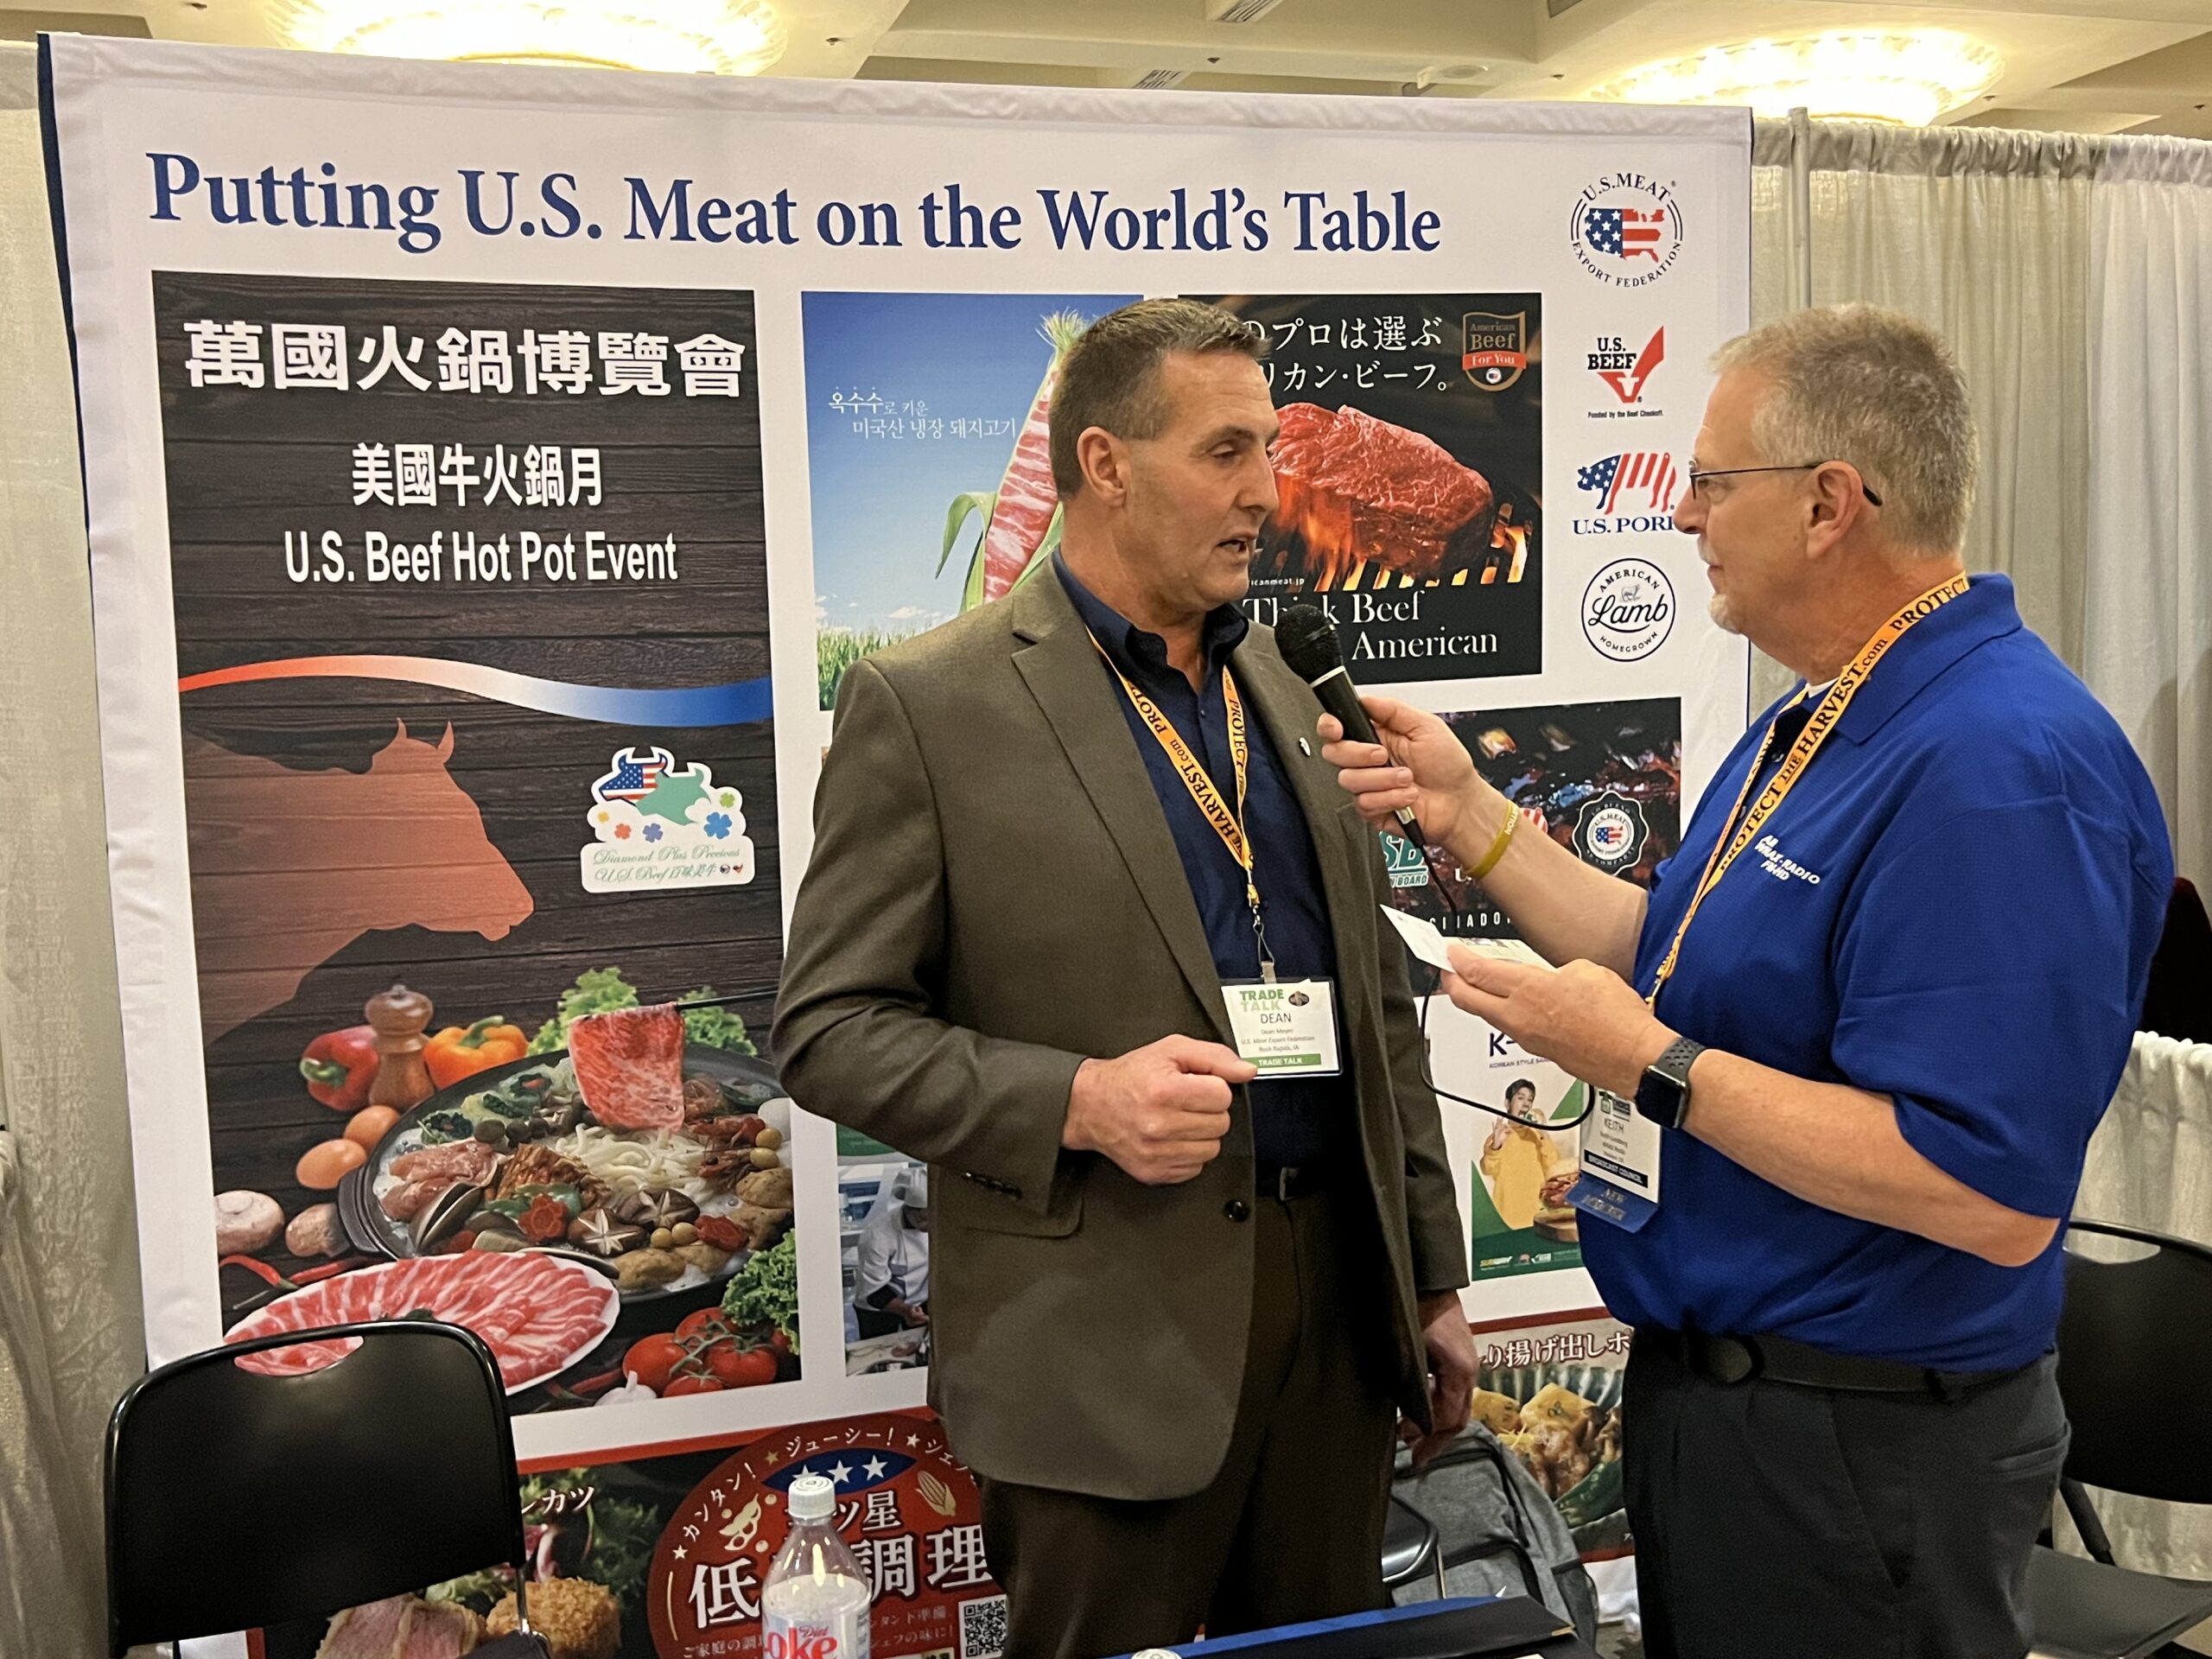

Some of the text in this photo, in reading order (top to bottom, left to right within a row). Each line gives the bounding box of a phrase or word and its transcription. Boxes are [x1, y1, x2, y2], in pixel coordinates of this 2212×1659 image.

[145, 153, 1442, 254] Putting U.S. Meat on the World’s Table
[1572, 241, 1681, 288] EXPORT FEDERATION
[1471, 333, 1516, 352] Beef
[1597, 337, 1627, 353] U.S.
[182, 318, 747, 398] 萬國火鍋博覽會
[1471, 353, 1516, 367] For You
[1587, 353, 1637, 371] BEEF
[853, 417, 1017, 440] 미국산 냉장 돼지고기
[351, 442, 603, 508] 美國牛火鍋月
[1572, 518, 1611, 536] U.S.
[284, 530, 679, 583] U.S. Beef Hot Pot Event
[1249, 576, 1305, 588] icanmeat.jp
[1599, 569, 1660, 593] AMERICAN
[1243, 590, 1426, 627] Thk Beef
[1587, 594, 1669, 632] Lamb
[1351, 626, 1498, 661] American
[1599, 631, 1659, 653] HOMEGROWN
[1777, 753, 1804, 785] THE
[1796, 638, 1889, 757] HARVEST.com
[593, 849, 655, 865] Diamond
[658, 846, 688, 861] Plus
[1239, 988, 1285, 1001] TRADE
[1240, 1001, 1282, 1012] TALK
[1260, 1013, 1292, 1024] DEAN
[1478, 1327, 1631, 1369] り揚げ出しポ
[688, 1524, 994, 1629] 低調理
[798, 1625, 830, 1637] Diet
[764, 1627, 838, 1659] oke
